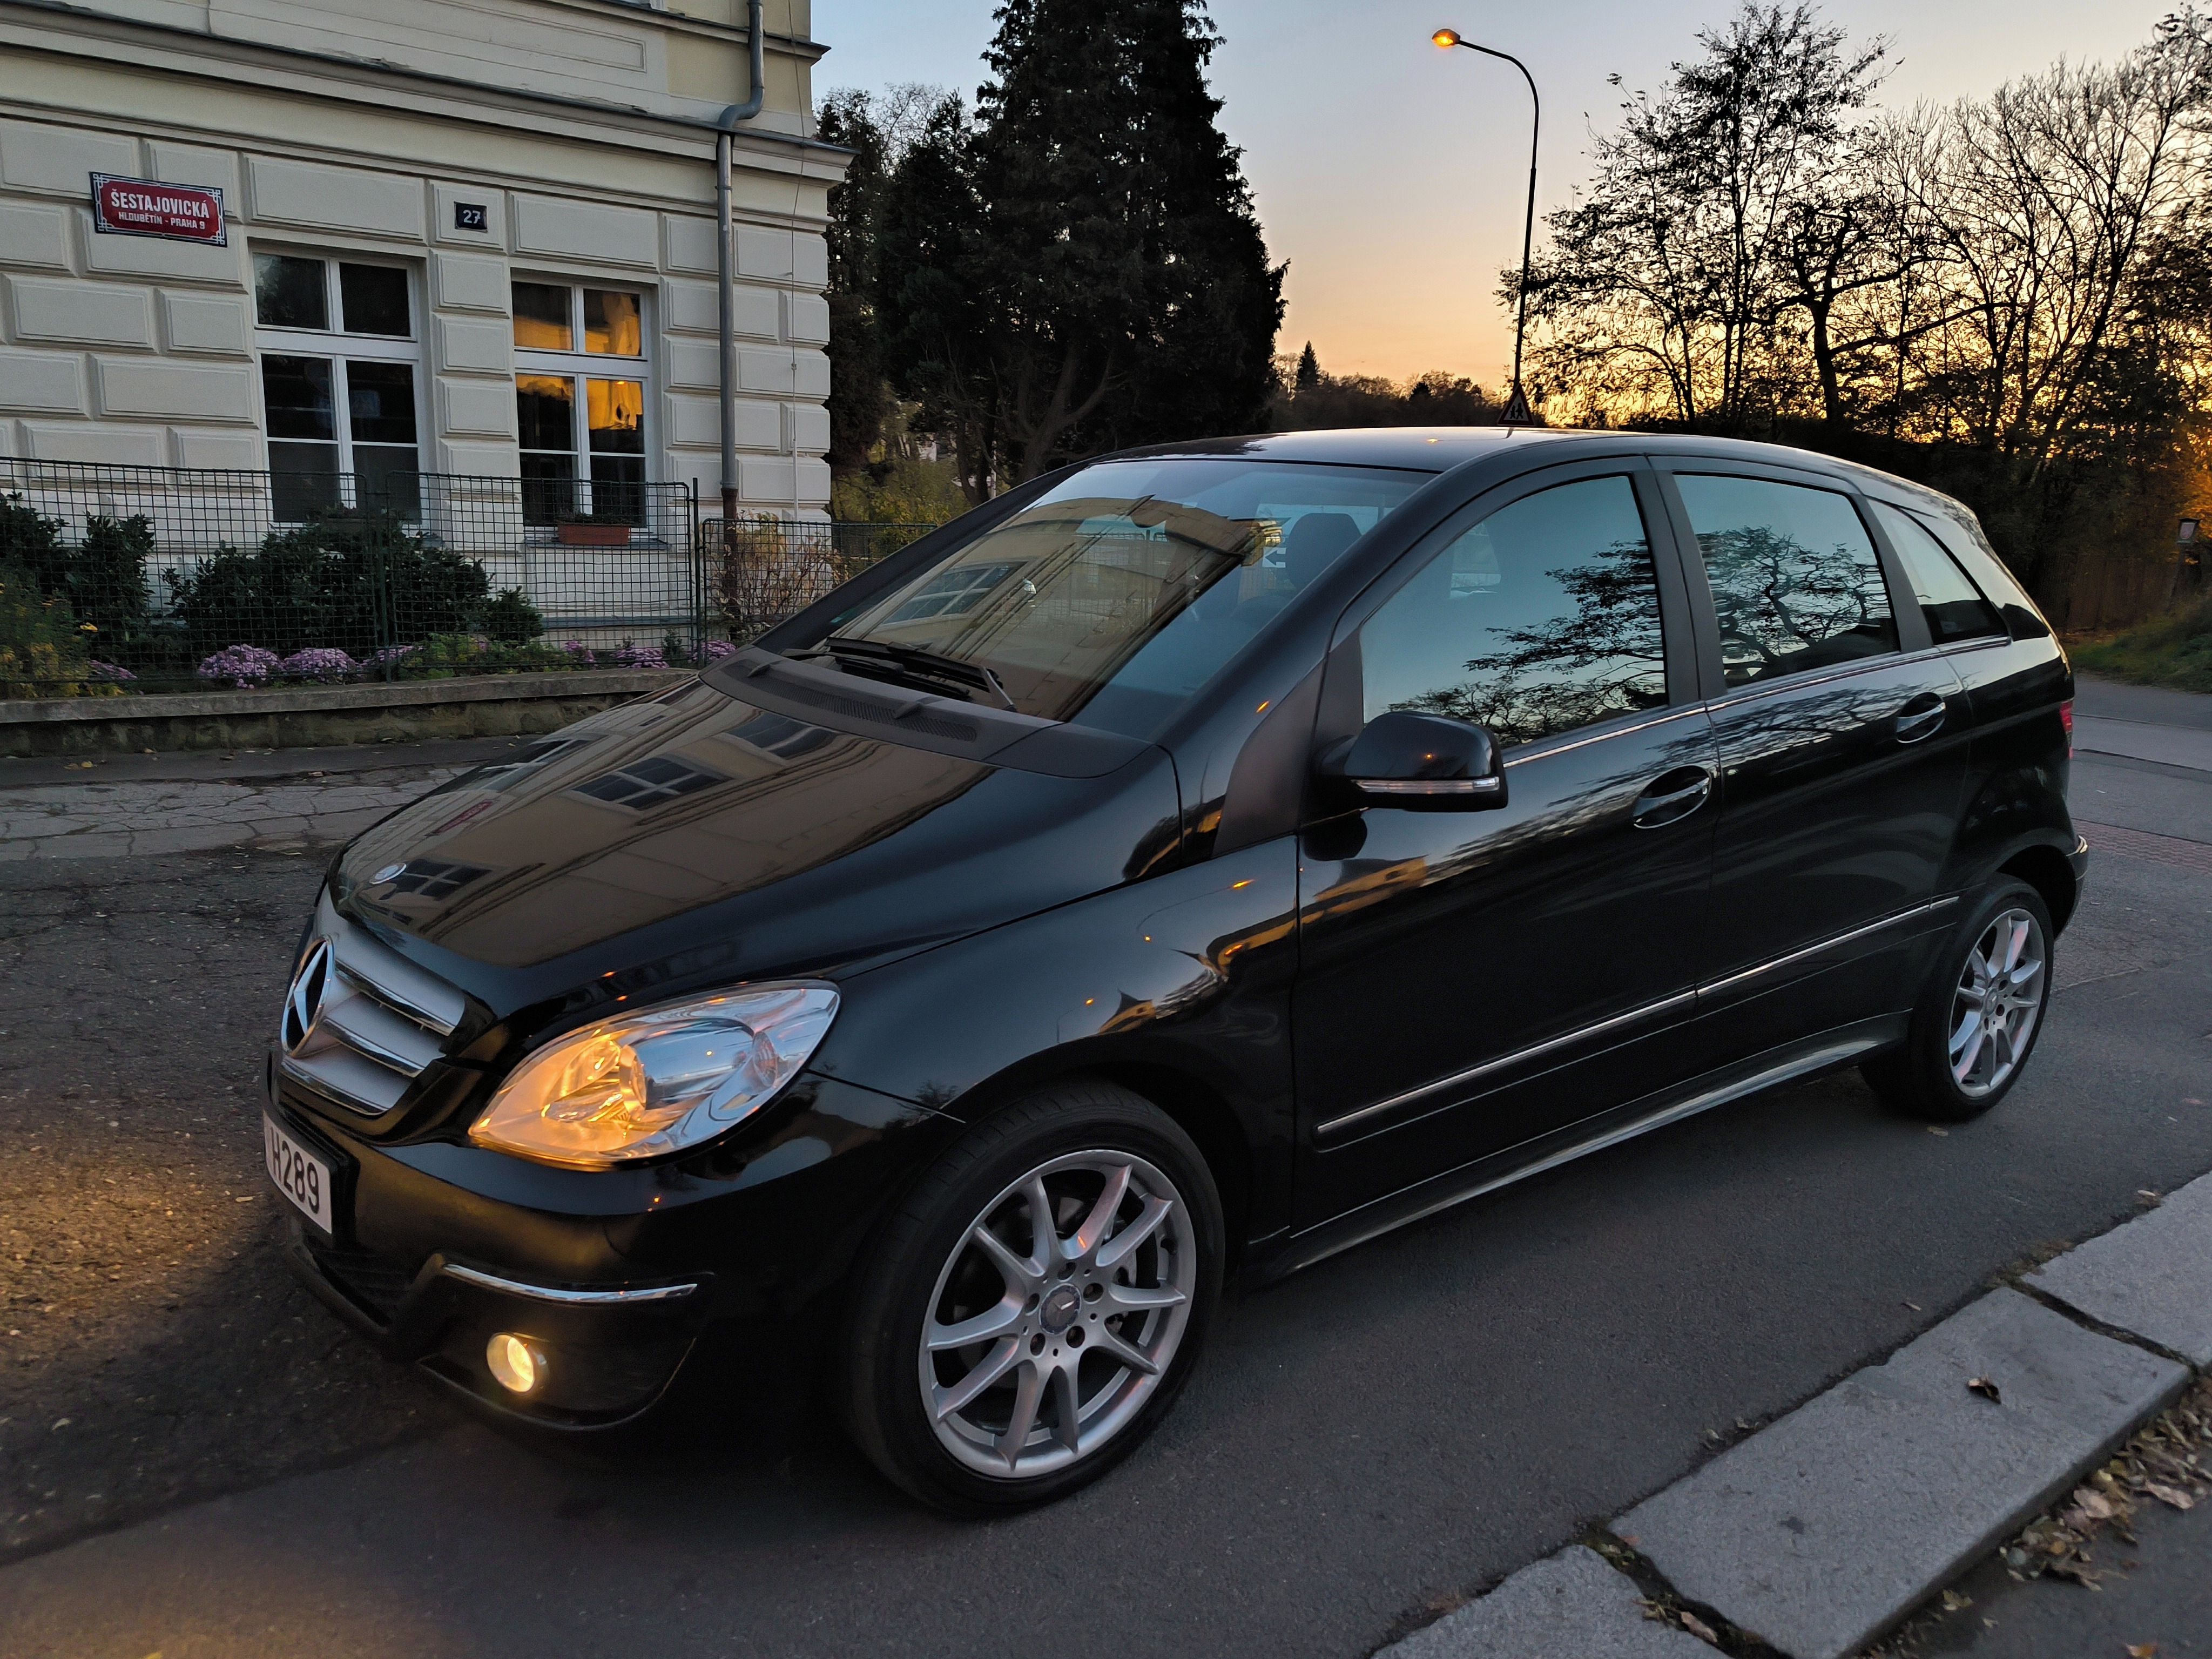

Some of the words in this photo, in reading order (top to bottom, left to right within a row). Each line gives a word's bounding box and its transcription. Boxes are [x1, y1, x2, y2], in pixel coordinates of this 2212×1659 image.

[111, 188, 210, 218] ŠESTAJOVICKÁ
[118, 211, 163, 225] HLOUBĚTÍN
[171, 217, 198, 229] PRAHA
[200, 221, 205, 230] 9
[463, 210, 481, 224] 27
[271, 1127, 320, 1215] H289
